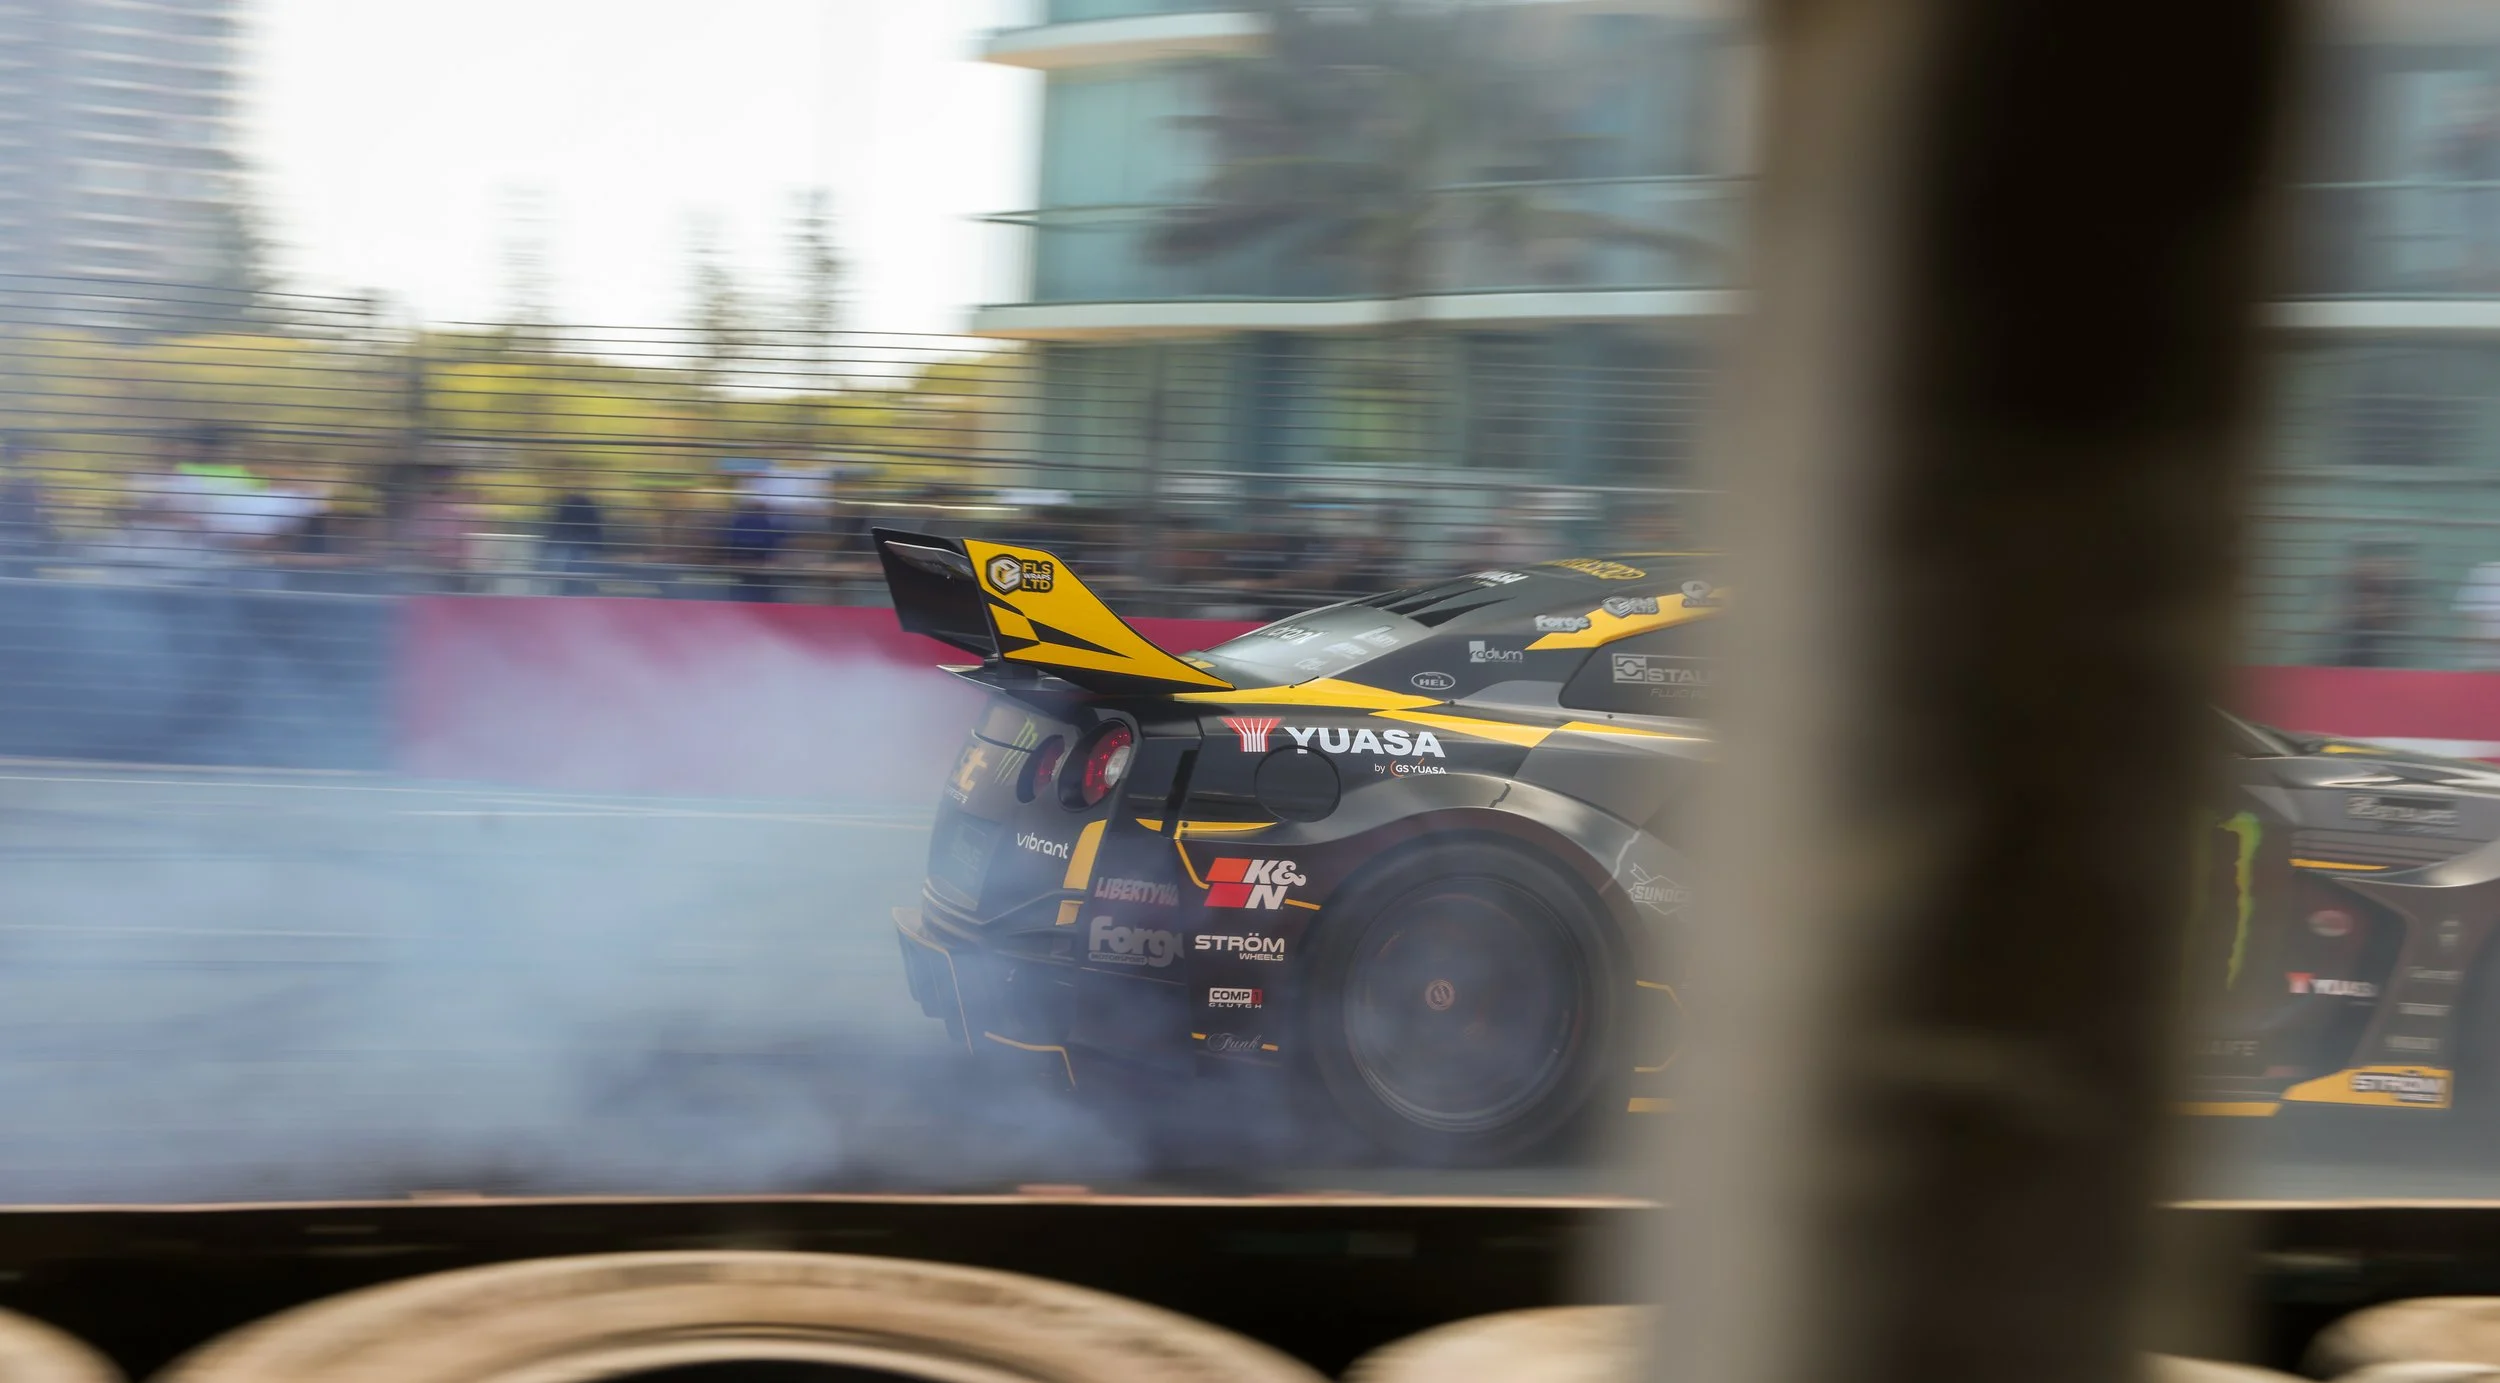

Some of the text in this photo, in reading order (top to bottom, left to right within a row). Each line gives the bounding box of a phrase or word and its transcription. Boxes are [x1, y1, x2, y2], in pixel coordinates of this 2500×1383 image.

[1022, 562, 1052, 574] FLS
[1023, 572, 1052, 581] WRAPS
[1022, 579, 1051, 590] LTD
[1534, 615, 1591, 632] Forge
[1469, 647, 1524, 661] radium
[1419, 678, 1448, 687] HEL
[1283, 726, 1446, 758] YUASA
[1374, 763, 1447, 775] by GS YUASA
[1017, 832, 1069, 859] vibrant
[1242, 859, 1307, 887] K&
[1244, 884, 1289, 910] N
[1634, 885, 1692, 903] SUNOC
[1194, 932, 1285, 953] STRÖM
[1239, 952, 1284, 962] WHEELS
[1211, 990, 1251, 1001] COMP
